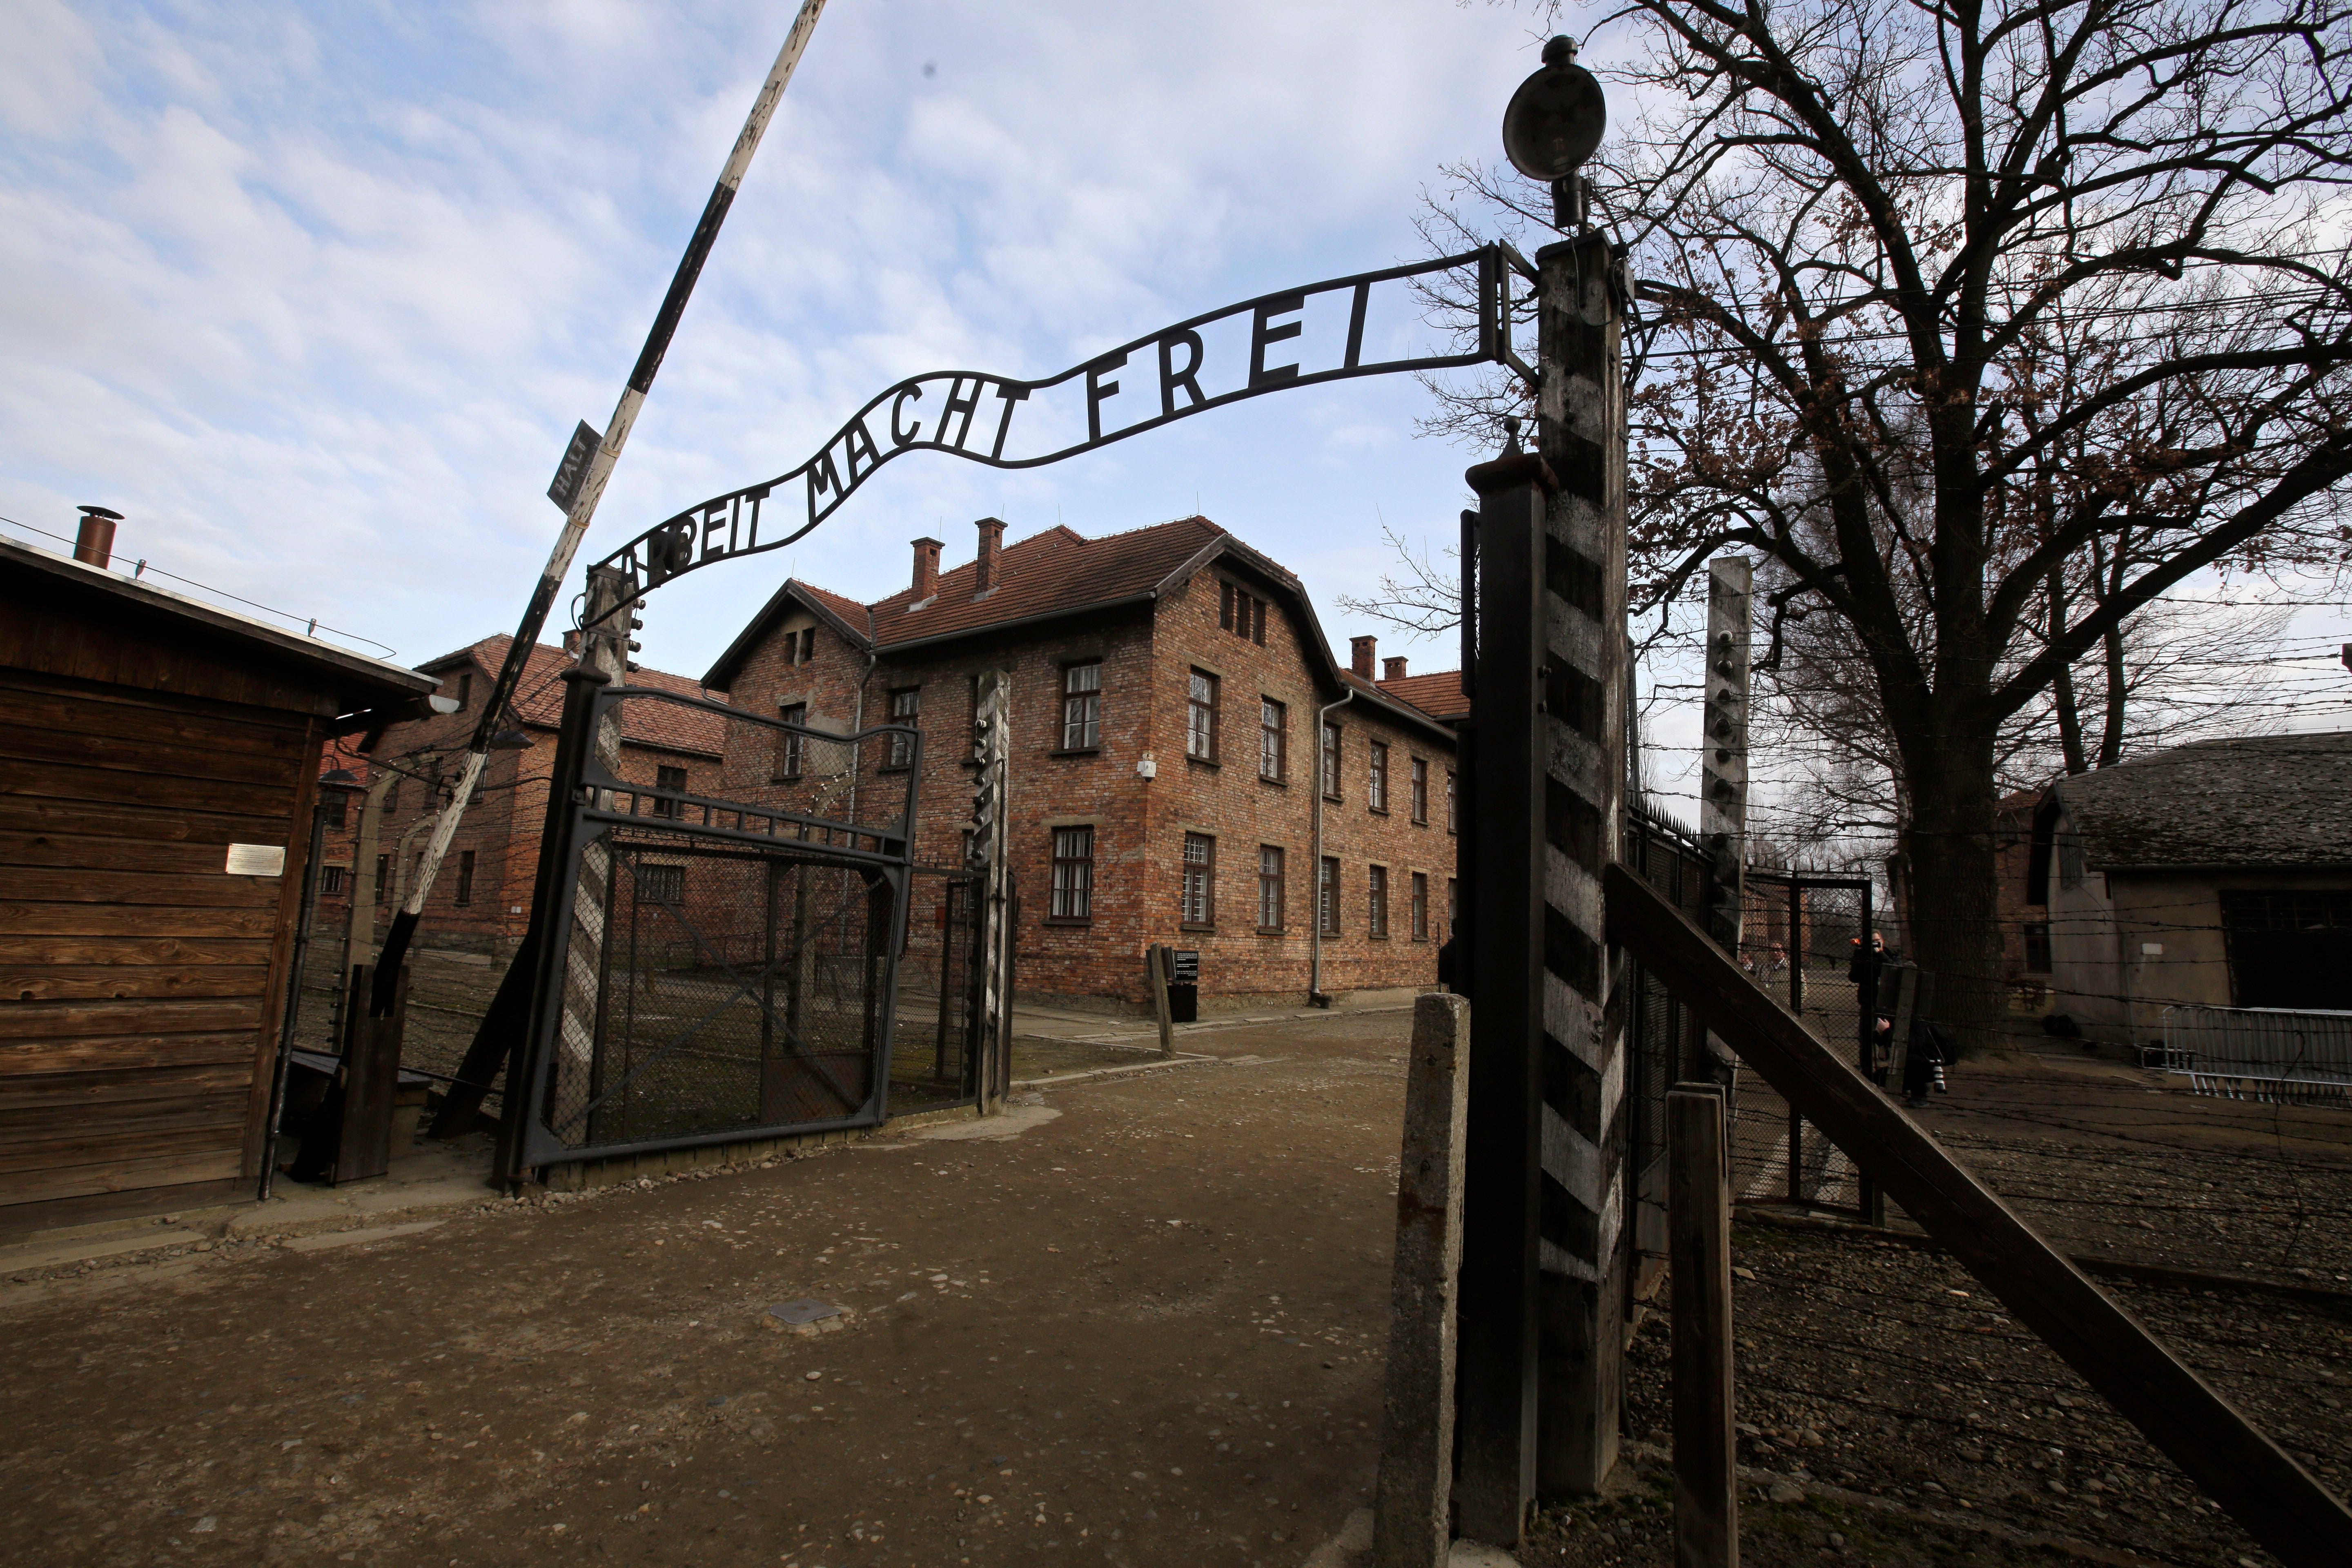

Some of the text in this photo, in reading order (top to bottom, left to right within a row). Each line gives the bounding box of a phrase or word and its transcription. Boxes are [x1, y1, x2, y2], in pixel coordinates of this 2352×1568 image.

[555, 433, 587, 497] HALT
[619, 282, 1371, 599] ARBEIT MACHT FREI
